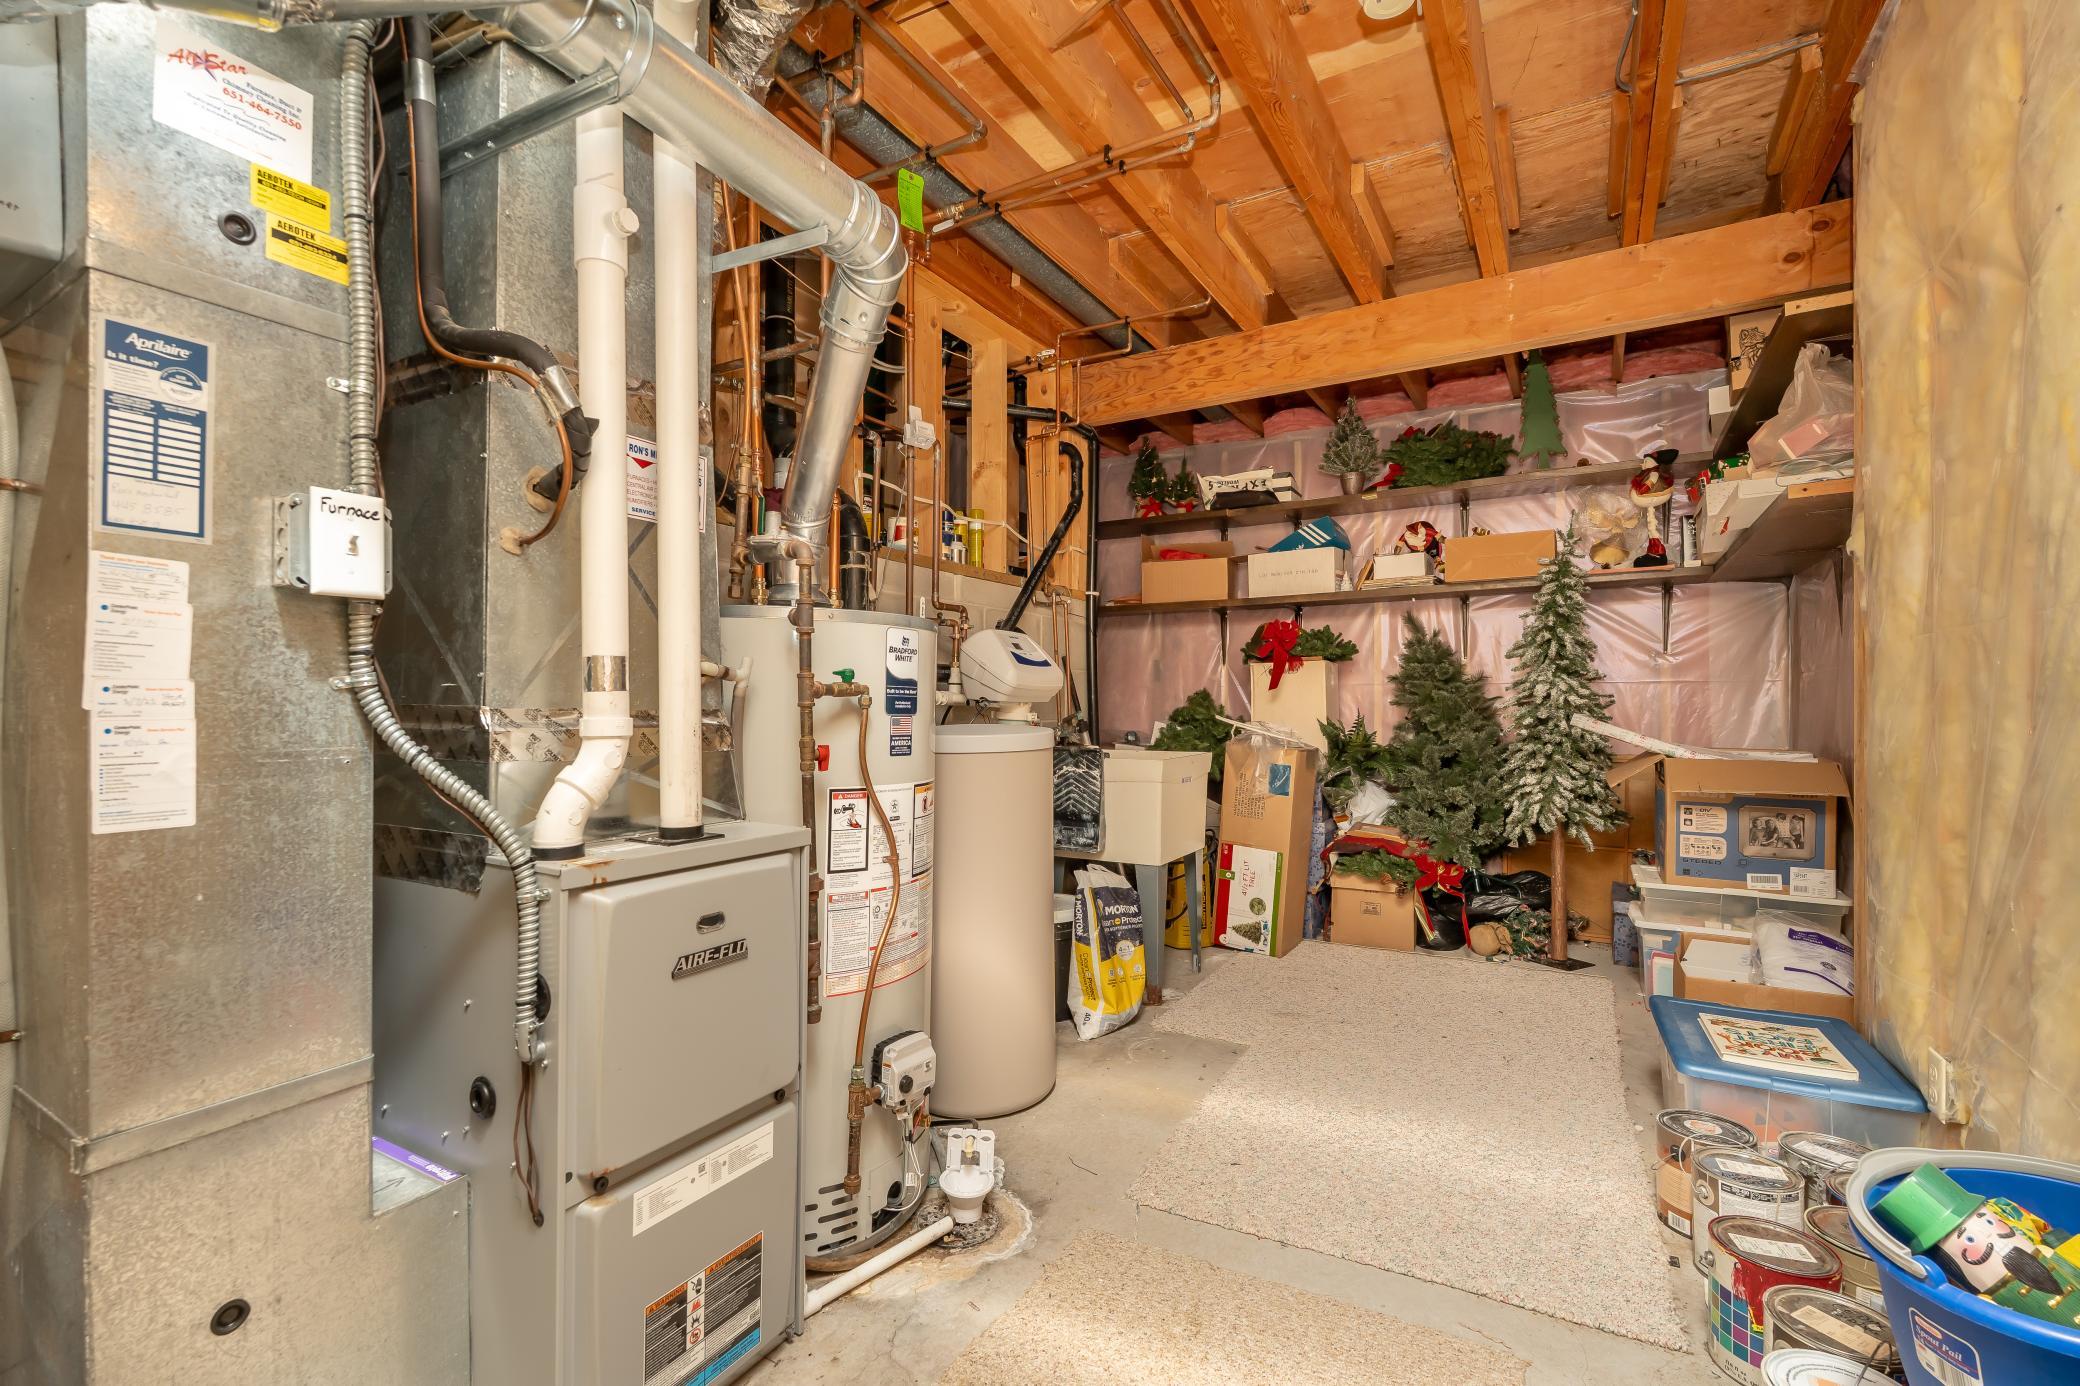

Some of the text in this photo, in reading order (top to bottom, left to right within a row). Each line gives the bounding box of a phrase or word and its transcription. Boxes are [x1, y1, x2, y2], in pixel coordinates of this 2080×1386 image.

[257, 169, 294, 190] AEROTEK
[277, 220, 316, 241] AEROTEK
[125, 332, 191, 359] Aprilaire
[629, 443, 649, 457] RON'S
[320, 496, 380, 520] Furnace
[888, 645, 918, 656] BRADFORD
[895, 654, 913, 663] WHITE
[1075, 900, 1084, 936] MORTON
[1104, 904, 1138, 916] MORTON
[674, 940, 748, 974] AIRE-FLO
